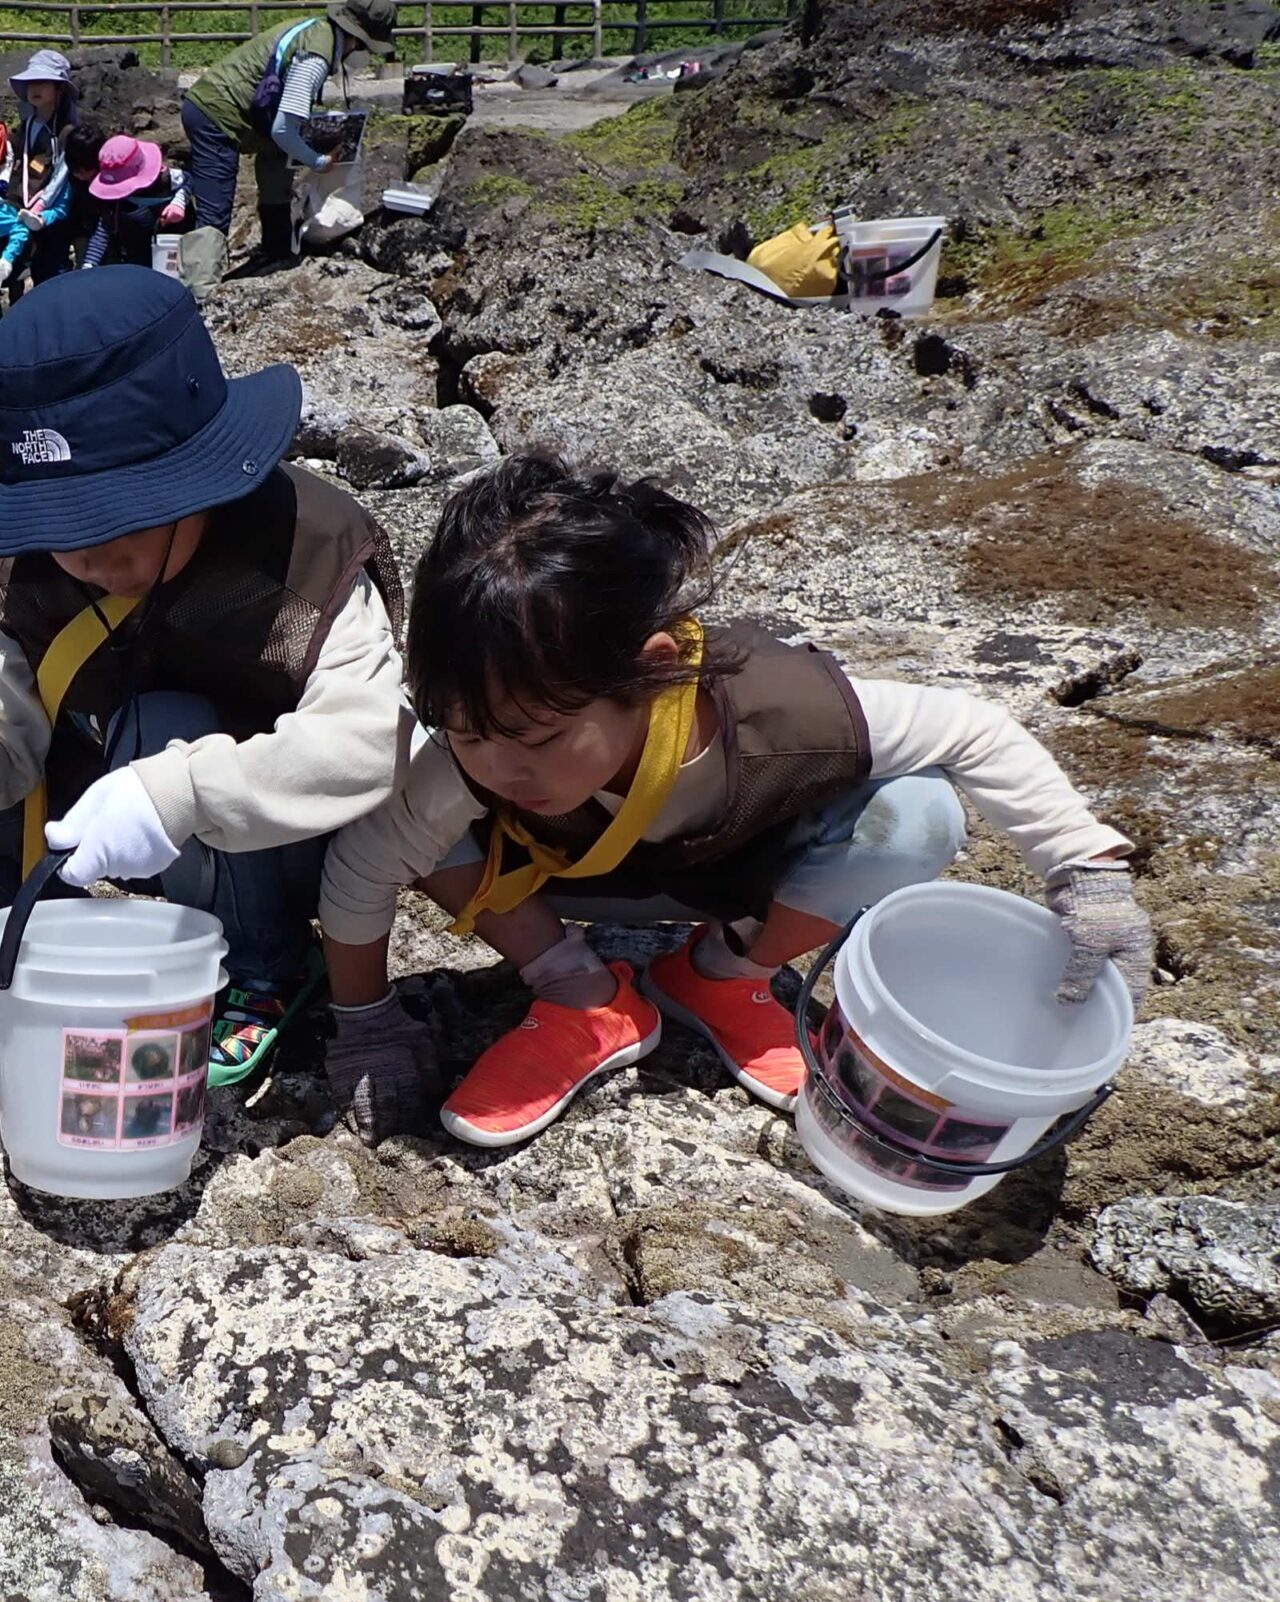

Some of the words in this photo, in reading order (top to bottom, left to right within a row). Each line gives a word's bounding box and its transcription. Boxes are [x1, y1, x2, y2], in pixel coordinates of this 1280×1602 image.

[22, 429, 45, 441] THE
[11, 440, 47, 454] NORTH
[22, 451, 49, 464] FACE
